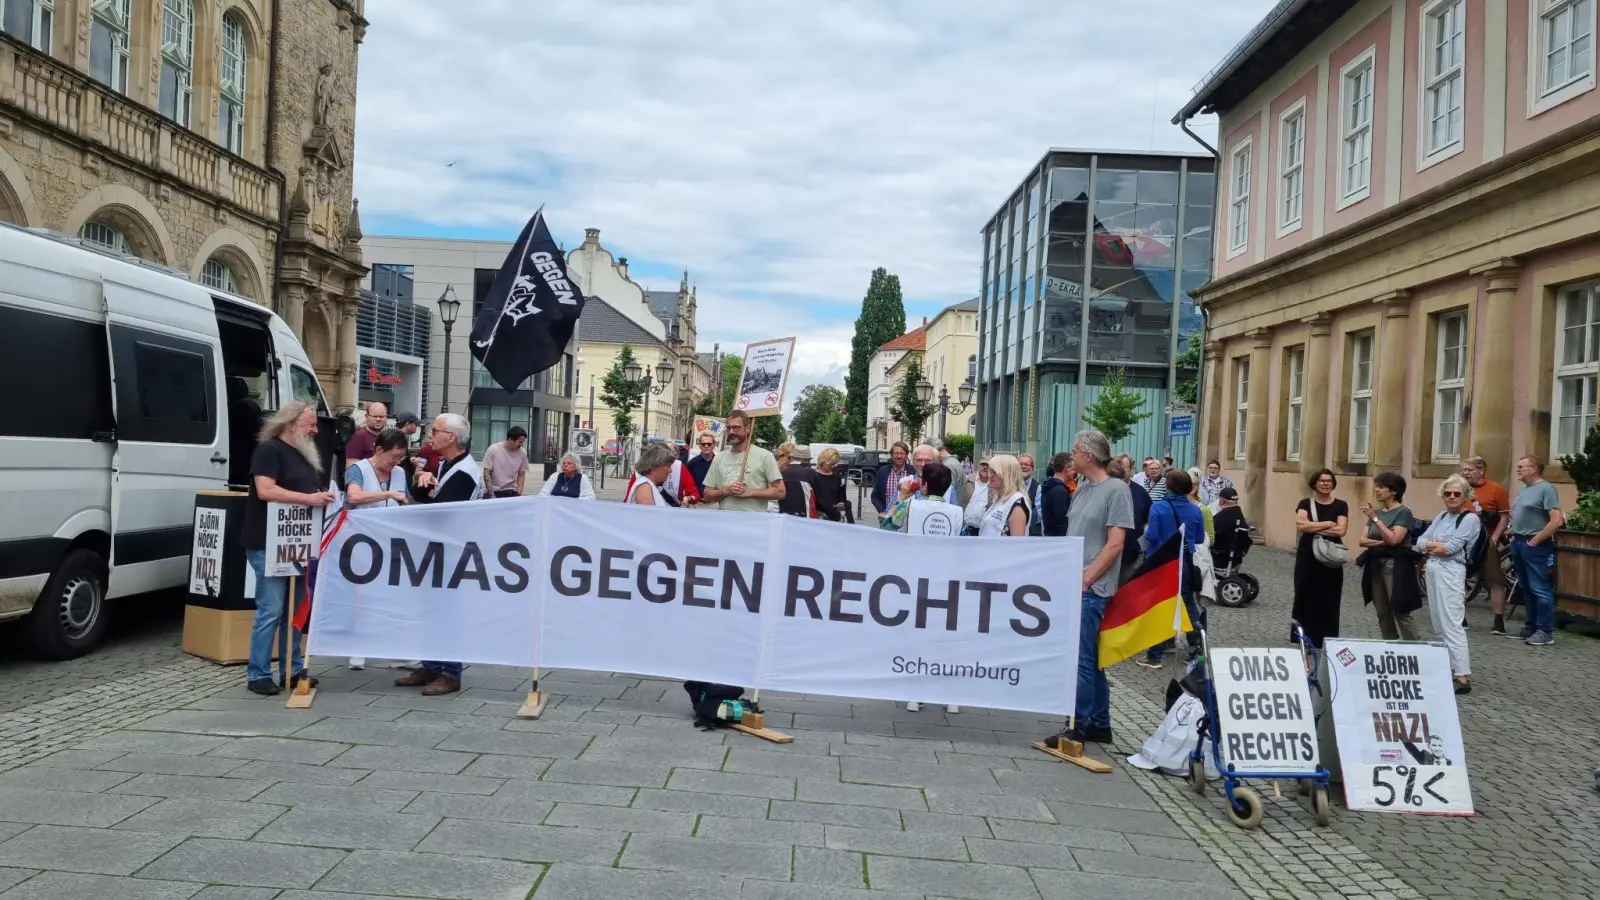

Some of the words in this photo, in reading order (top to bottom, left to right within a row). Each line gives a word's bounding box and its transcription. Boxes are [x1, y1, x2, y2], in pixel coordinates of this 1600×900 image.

[530, 251, 578, 306] GEGEN
[199, 511, 220, 531] BJÖRN
[278, 505, 313, 521] BJÖRN
[197, 530, 219, 550] HÖCKE
[277, 521, 312, 537] HÖCKE
[276, 543, 312, 563] NAZI
[195, 556, 216, 581] NAZI
[338, 533, 530, 594] OMAS
[550, 545, 765, 613] GEGEN
[784, 565, 1052, 638] RECHTS
[891, 656, 1021, 686] Schaumburg
[1228, 655, 1290, 682] OMAS
[1364, 651, 1420, 675] BJÖRN
[1367, 675, 1424, 700] HÖCKE
[1228, 693, 1303, 720] GEGEN
[1386, 701, 1397, 710] IST
[1398, 702, 1410, 710] EIN
[1372, 712, 1432, 744] NAZI
[1227, 732, 1314, 762] RECHTS
